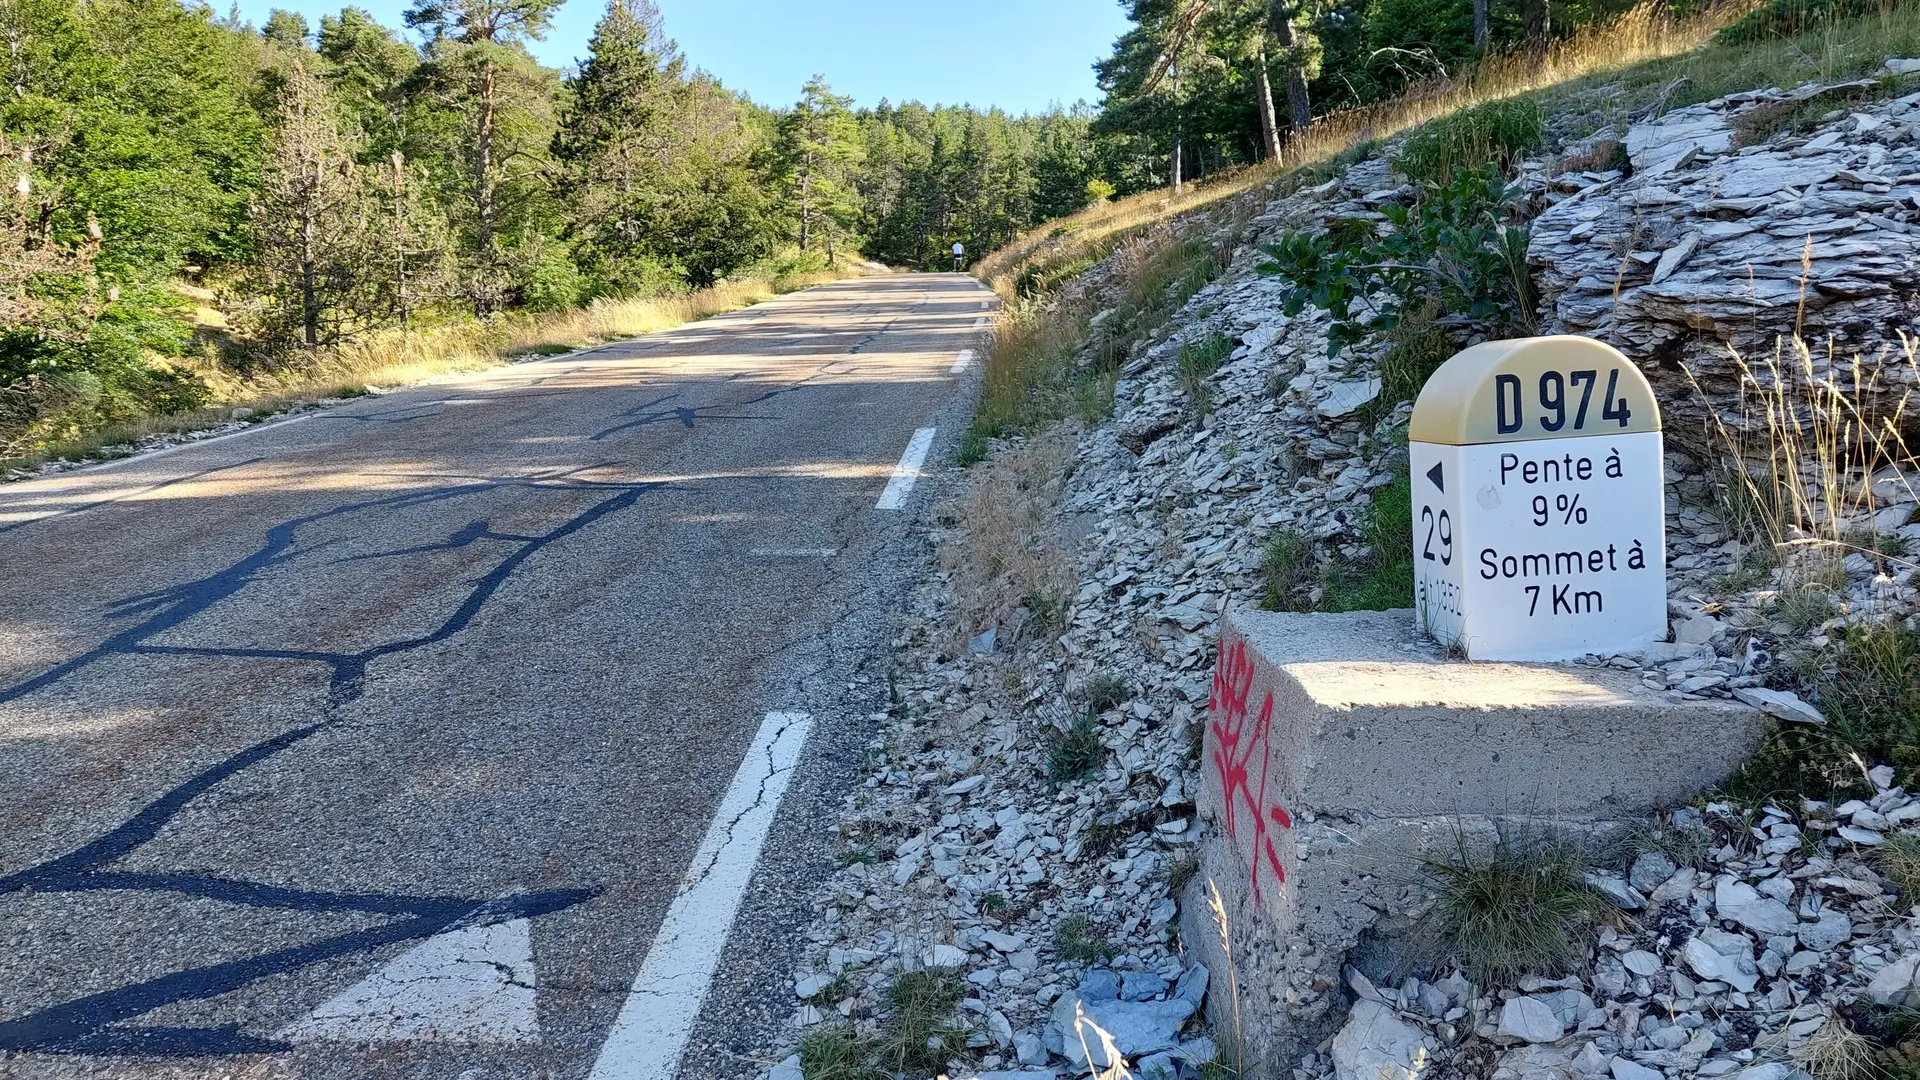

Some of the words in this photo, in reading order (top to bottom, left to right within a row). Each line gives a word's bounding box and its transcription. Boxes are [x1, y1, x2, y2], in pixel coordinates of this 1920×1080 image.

[1494, 373, 1524, 435] D
[1538, 367, 1632, 432] 974
[1500, 453, 1593, 486] Pente
[1605, 447, 1624, 479] à
[1532, 493, 1588, 527] 9%
[1421, 504, 1453, 567] 29
[1480, 543, 1618, 580] Sommet
[1627, 538, 1646, 570] à
[1524, 585, 1541, 617] 7
[1552, 583, 1603, 616] Km
